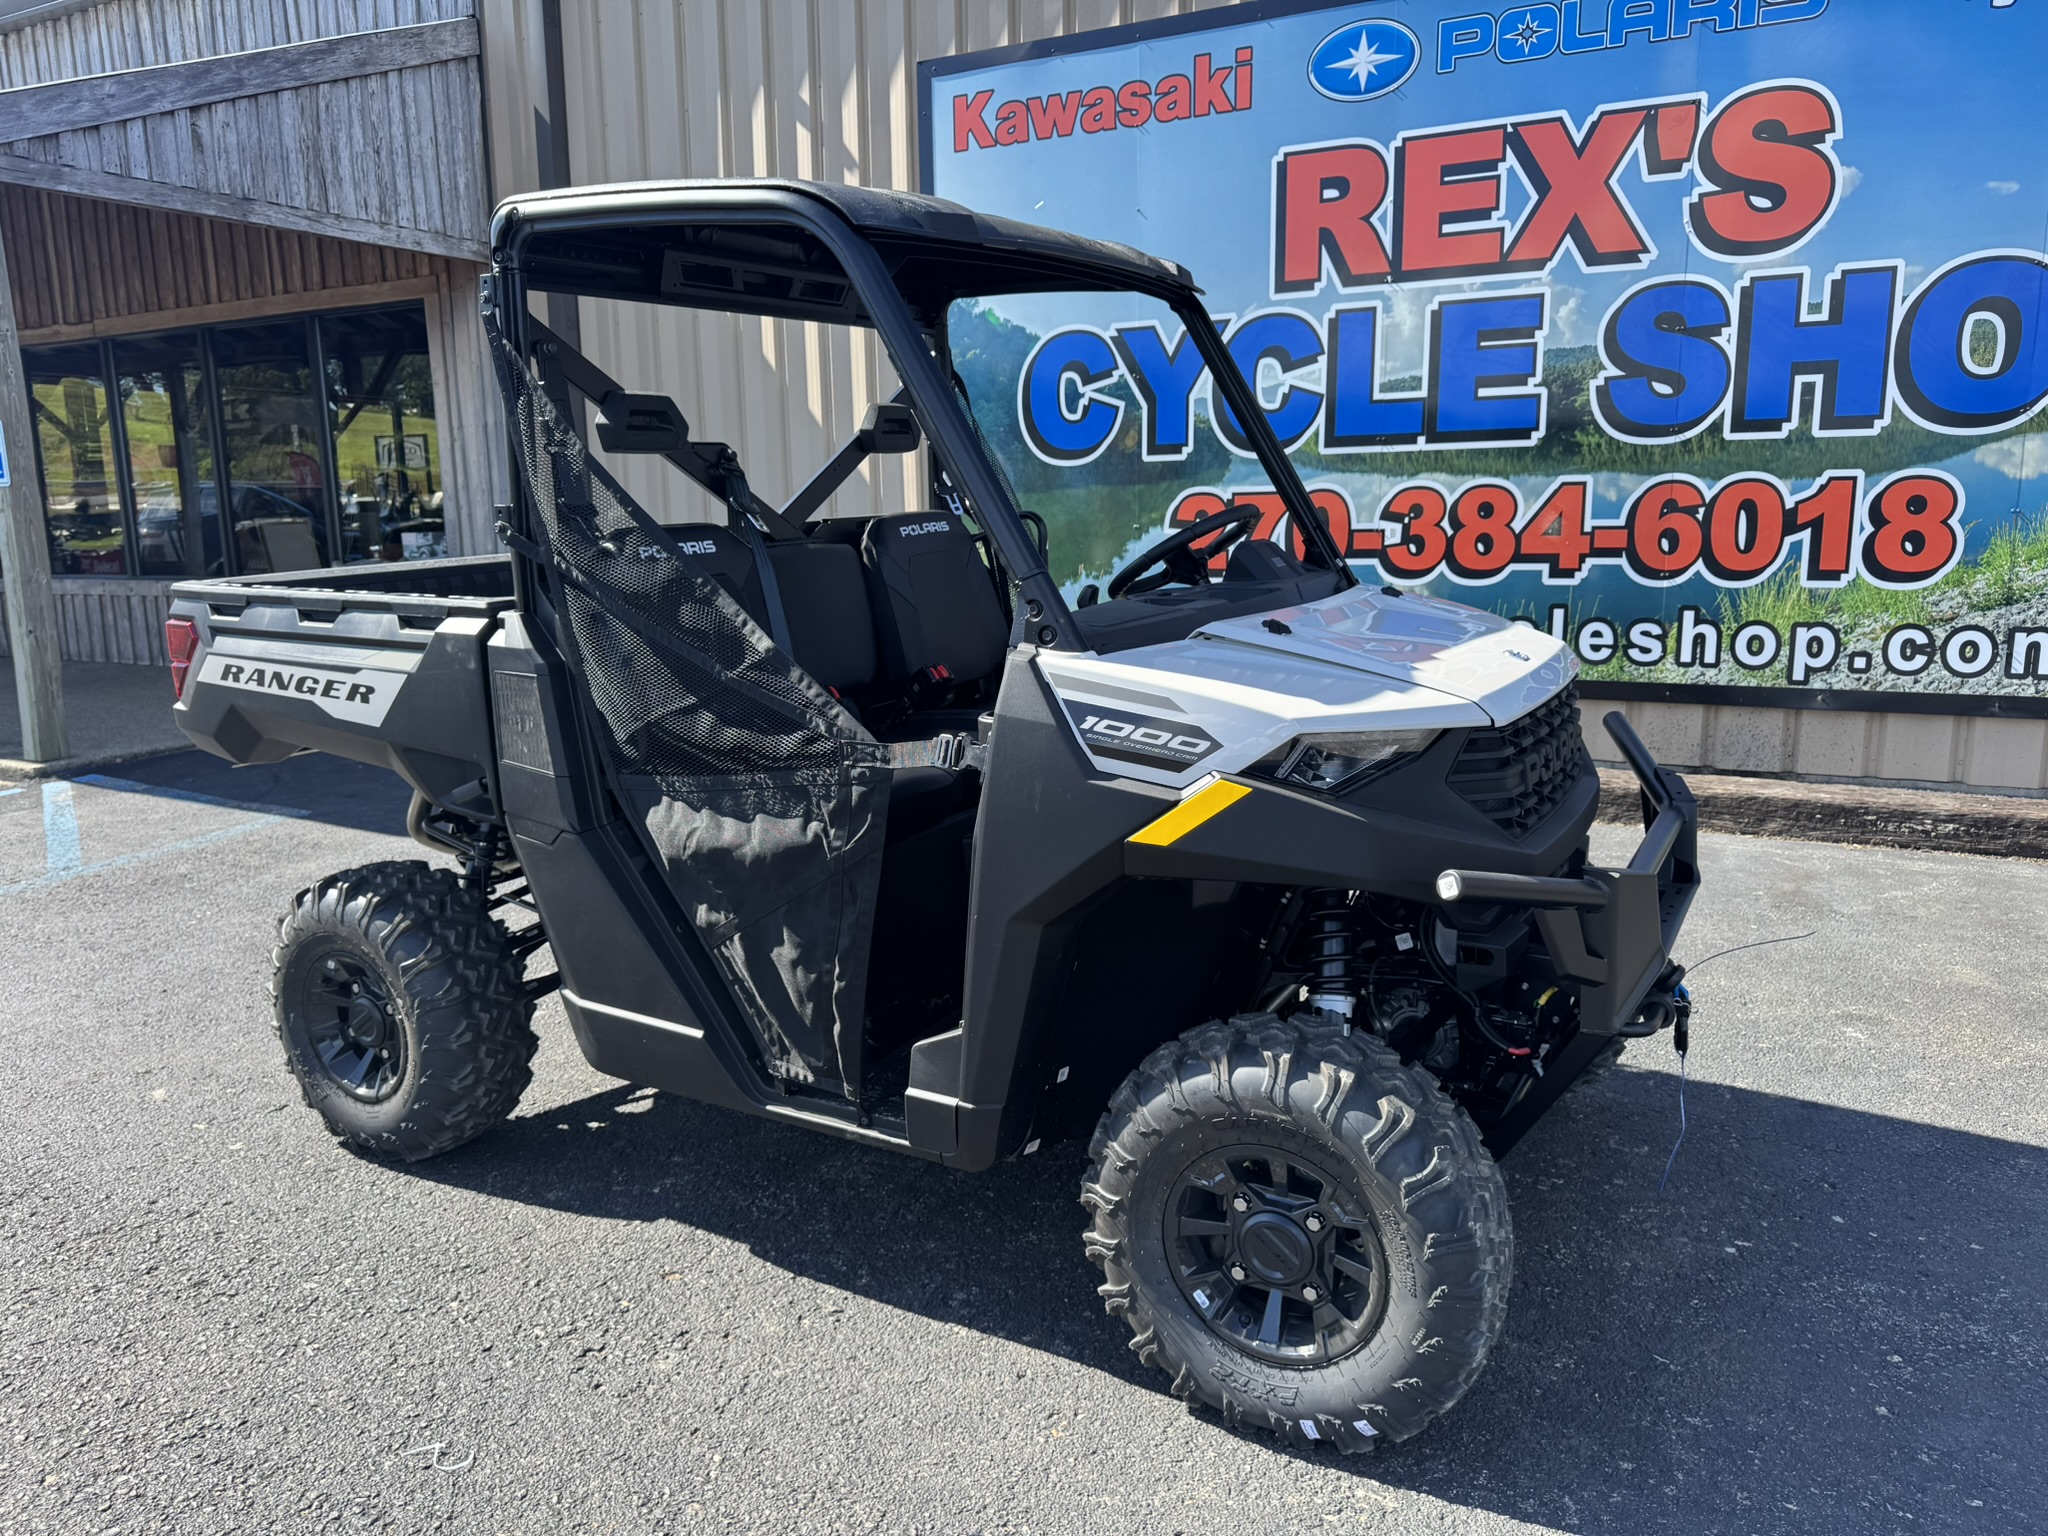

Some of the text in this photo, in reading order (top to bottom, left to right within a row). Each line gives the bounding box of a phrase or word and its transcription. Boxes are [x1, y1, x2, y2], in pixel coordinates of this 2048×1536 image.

[952, 45, 1254, 153] Kawasaki
[1272, 78, 1843, 299] REX'S
[1017, 247, 2048, 466] CYCLE SHO
[899, 521, 950, 538] POLARIS
[219, 663, 376, 704] RANGER
[1079, 715, 1211, 753] 1000
[1085, 732, 1198, 761] SINGLE OVERHEAD CAM
